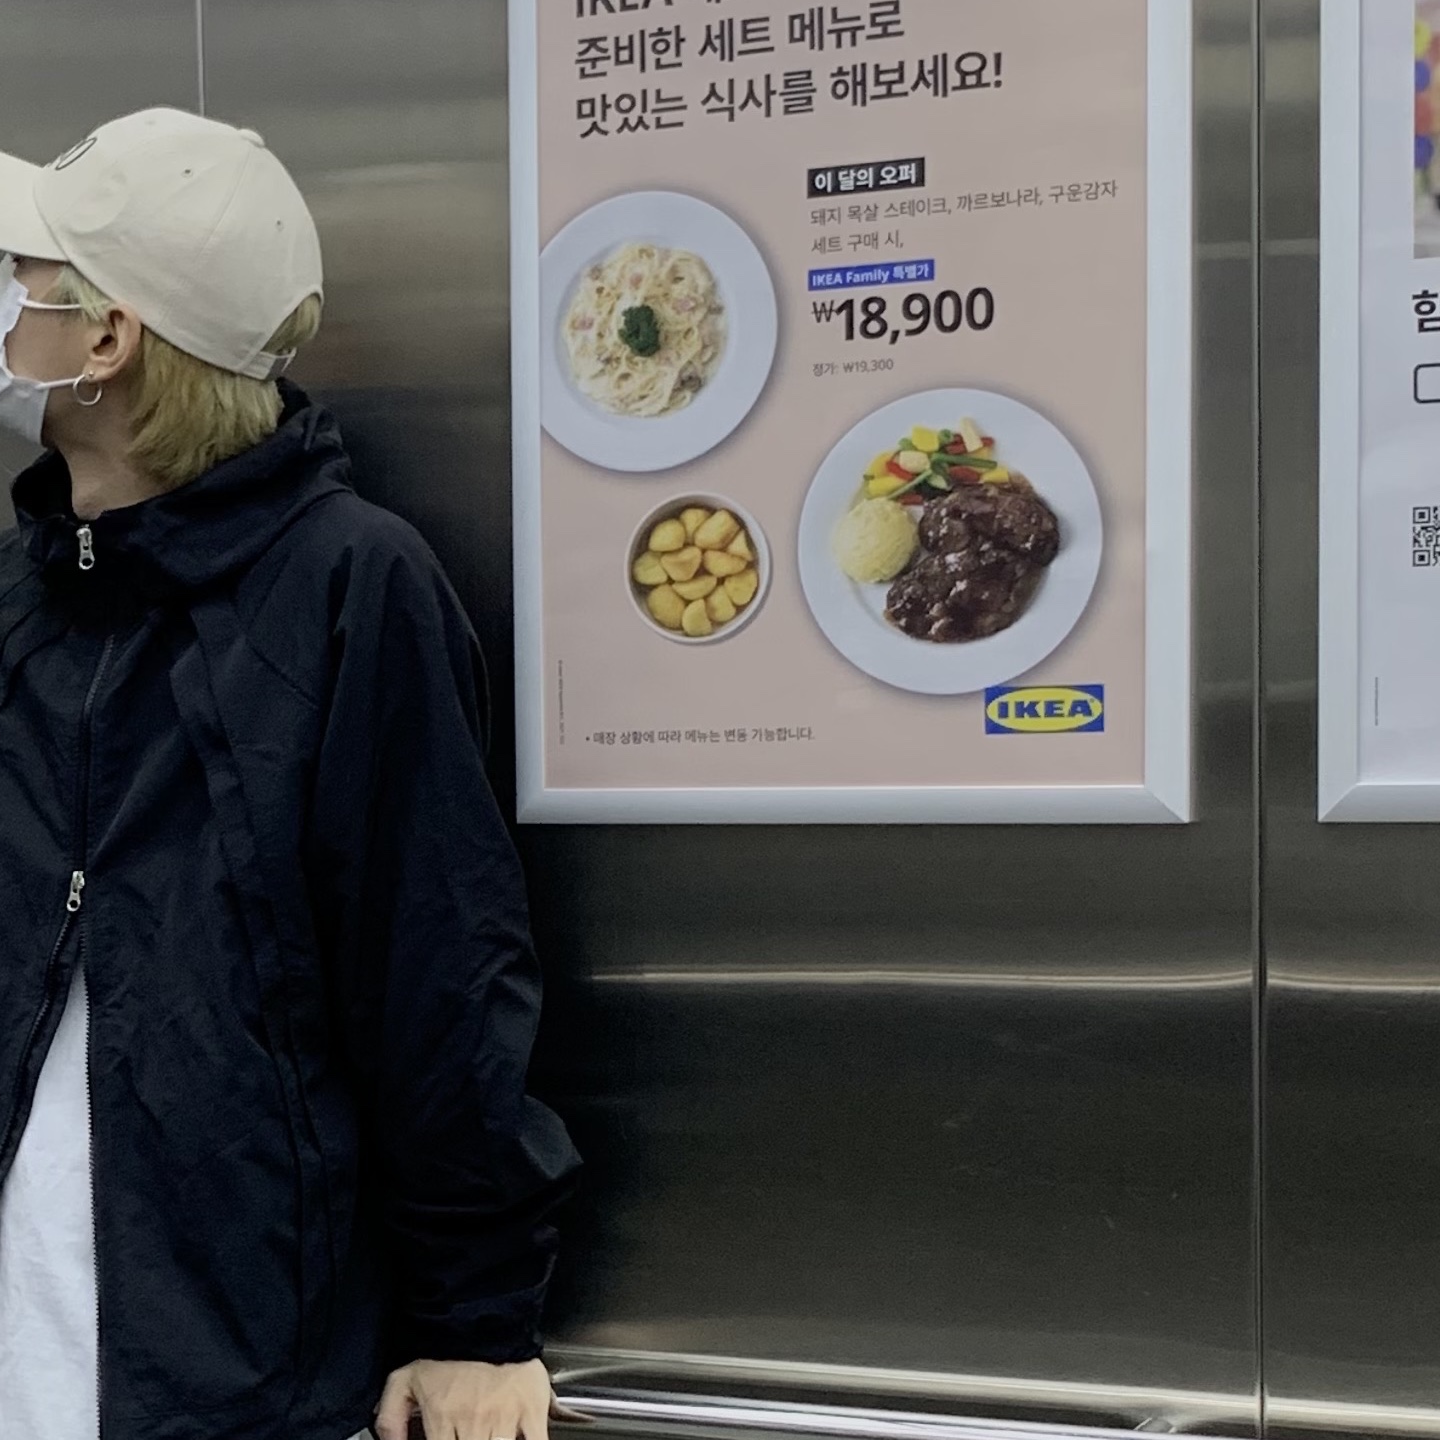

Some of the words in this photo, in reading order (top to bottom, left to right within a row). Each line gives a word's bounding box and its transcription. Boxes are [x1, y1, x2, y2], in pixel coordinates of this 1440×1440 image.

[575, 25, 686, 79] 준비한
[698, 17, 775, 62] 세트
[788, 0, 905, 51] 메뉴로
[576, 88, 688, 139] 맛있는
[700, 70, 817, 122] 식사를
[830, 51, 1003, 107] 해보세요!
[814, 172, 833, 193] 이
[838, 166, 874, 191] 달의
[879, 163, 917, 184] 오퍼
[811, 207, 842, 226] 돼지
[847, 203, 879, 223] 목살
[884, 197, 952, 218] 스테이크,
[956, 187, 1044, 212] 까르보나라,
[1048, 179, 1119, 204] 구운감자
[811, 236, 843, 254] 세트
[847, 231, 879, 251] 구매
[812, 272, 843, 287] IKEA
[846, 268, 890, 284] Family
[893, 263, 930, 280] 특별가
[997, 699, 1093, 719] IKEA
